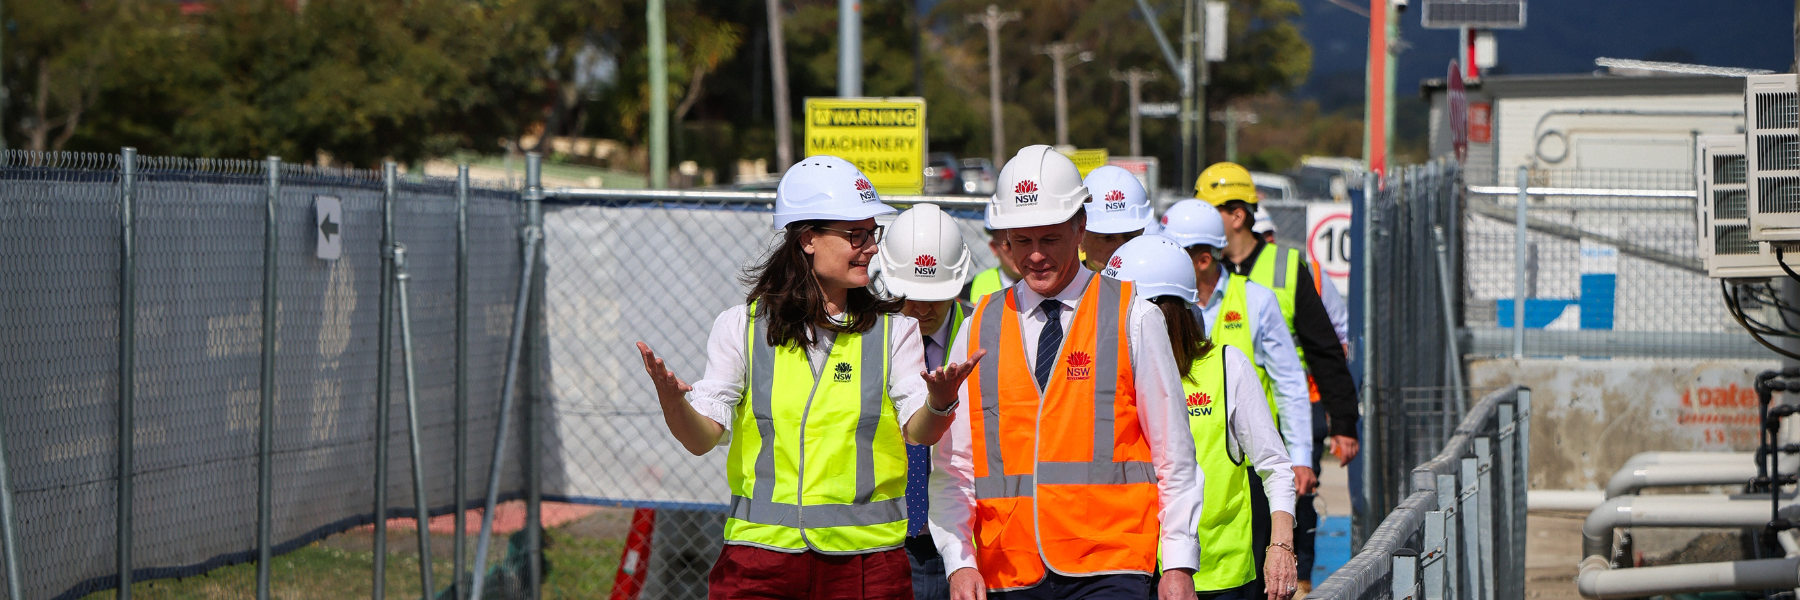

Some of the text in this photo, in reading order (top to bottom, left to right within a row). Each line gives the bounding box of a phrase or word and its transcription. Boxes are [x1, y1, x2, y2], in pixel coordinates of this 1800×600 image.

[832, 108, 916, 125] WARNING
[812, 136, 916, 152] MACHINERY
[856, 157, 910, 173] SSING
[860, 190, 876, 200] NSW
[1015, 194, 1038, 203] NSW
[1105, 202, 1126, 210] NSW
[914, 267, 937, 275] NSW
[834, 372, 852, 380] NSW
[1066, 367, 1091, 376] NSW
